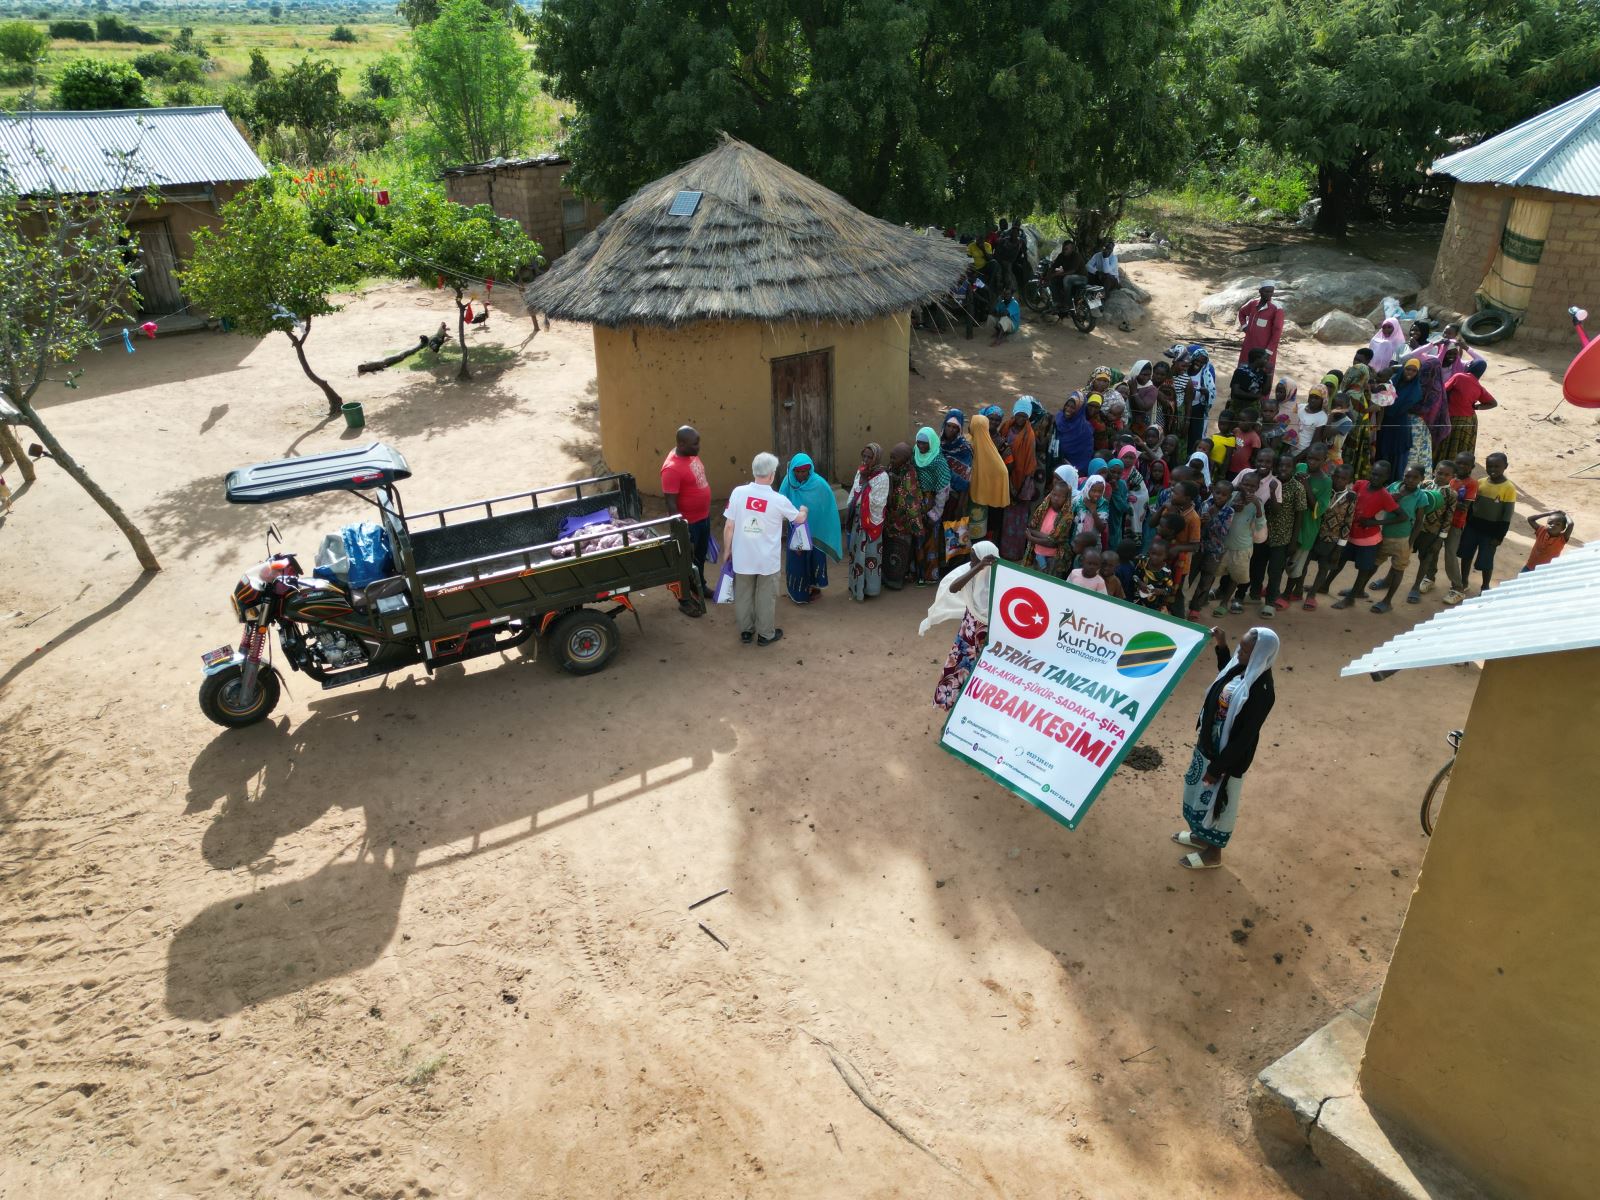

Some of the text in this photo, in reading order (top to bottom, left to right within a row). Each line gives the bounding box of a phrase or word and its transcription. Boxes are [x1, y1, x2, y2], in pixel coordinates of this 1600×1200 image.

[1057, 629, 1117, 661] Kurban
[1058, 608, 1124, 647] Afrika
[1056, 641, 1109, 665] Organizasyonu
[986, 640, 1140, 722] AFRİKA TANZANYA
[964, 675, 1037, 723] KURBAN
[1028, 707, 1117, 768] KESİMİ
